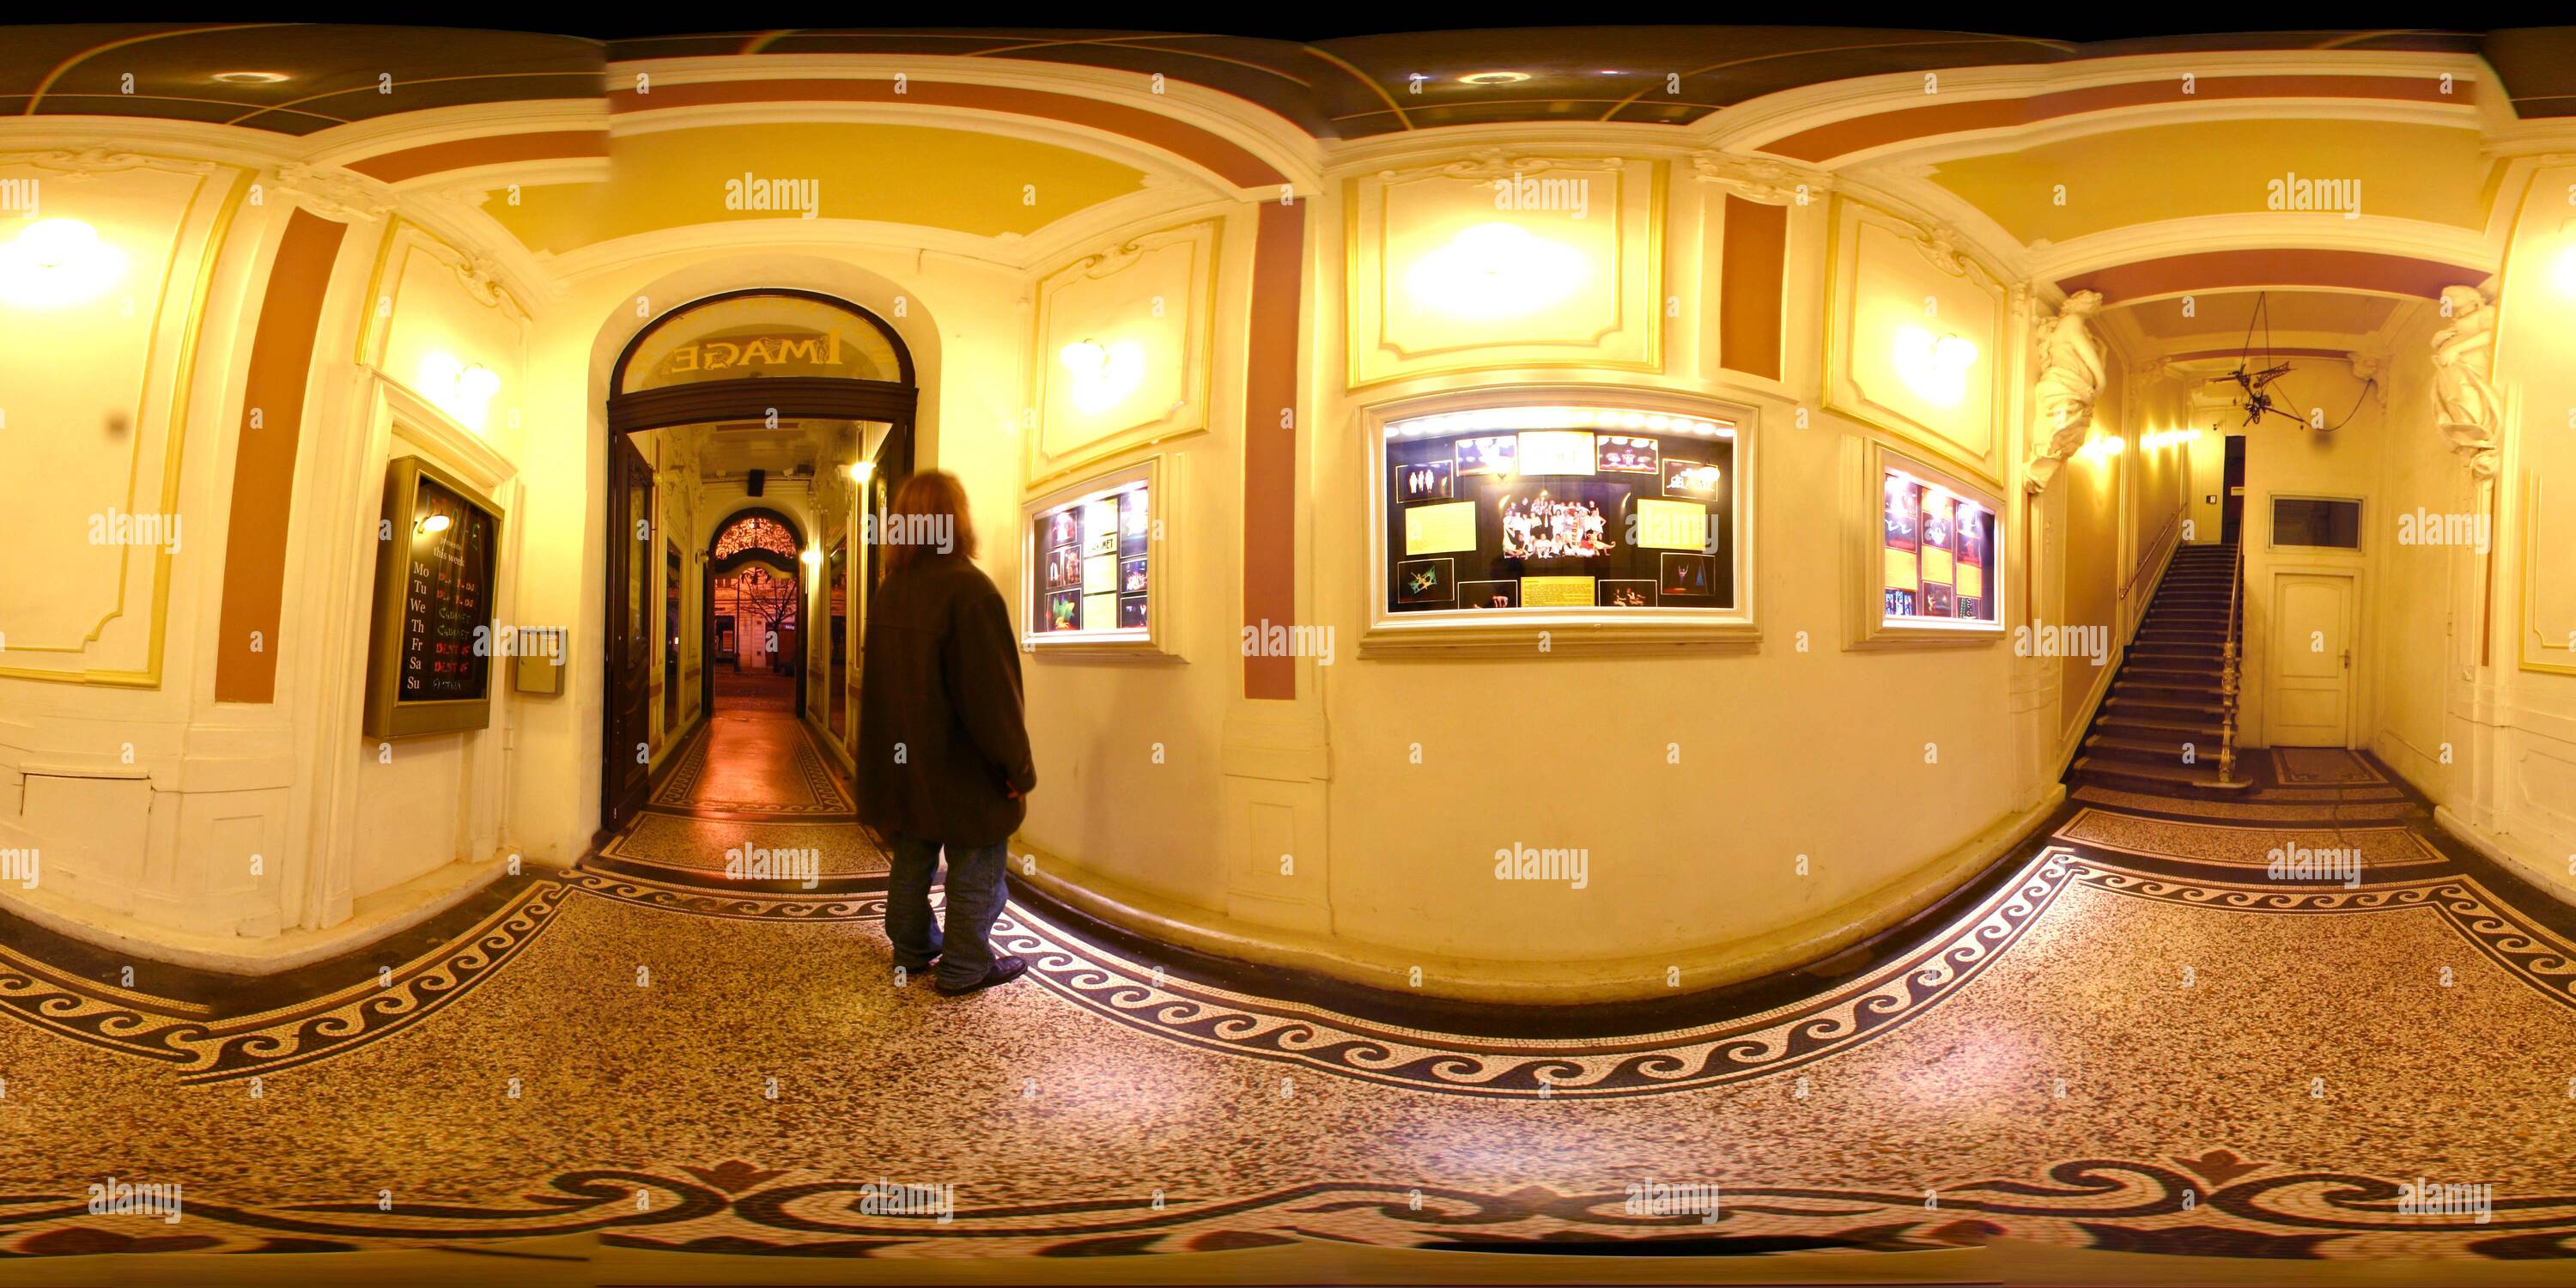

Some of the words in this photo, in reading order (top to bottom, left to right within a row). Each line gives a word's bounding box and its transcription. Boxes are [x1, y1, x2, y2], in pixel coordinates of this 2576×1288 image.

[434, 546, 447, 560] this
[448, 554, 465, 567] week
[413, 562, 429, 578] Mo
[414, 580, 427, 595] Tu
[410, 598, 426, 613] We
[411, 619, 424, 634] Th
[411, 637, 423, 652] Fr
[409, 656, 422, 670] Sa
[407, 676, 420, 690] Su
